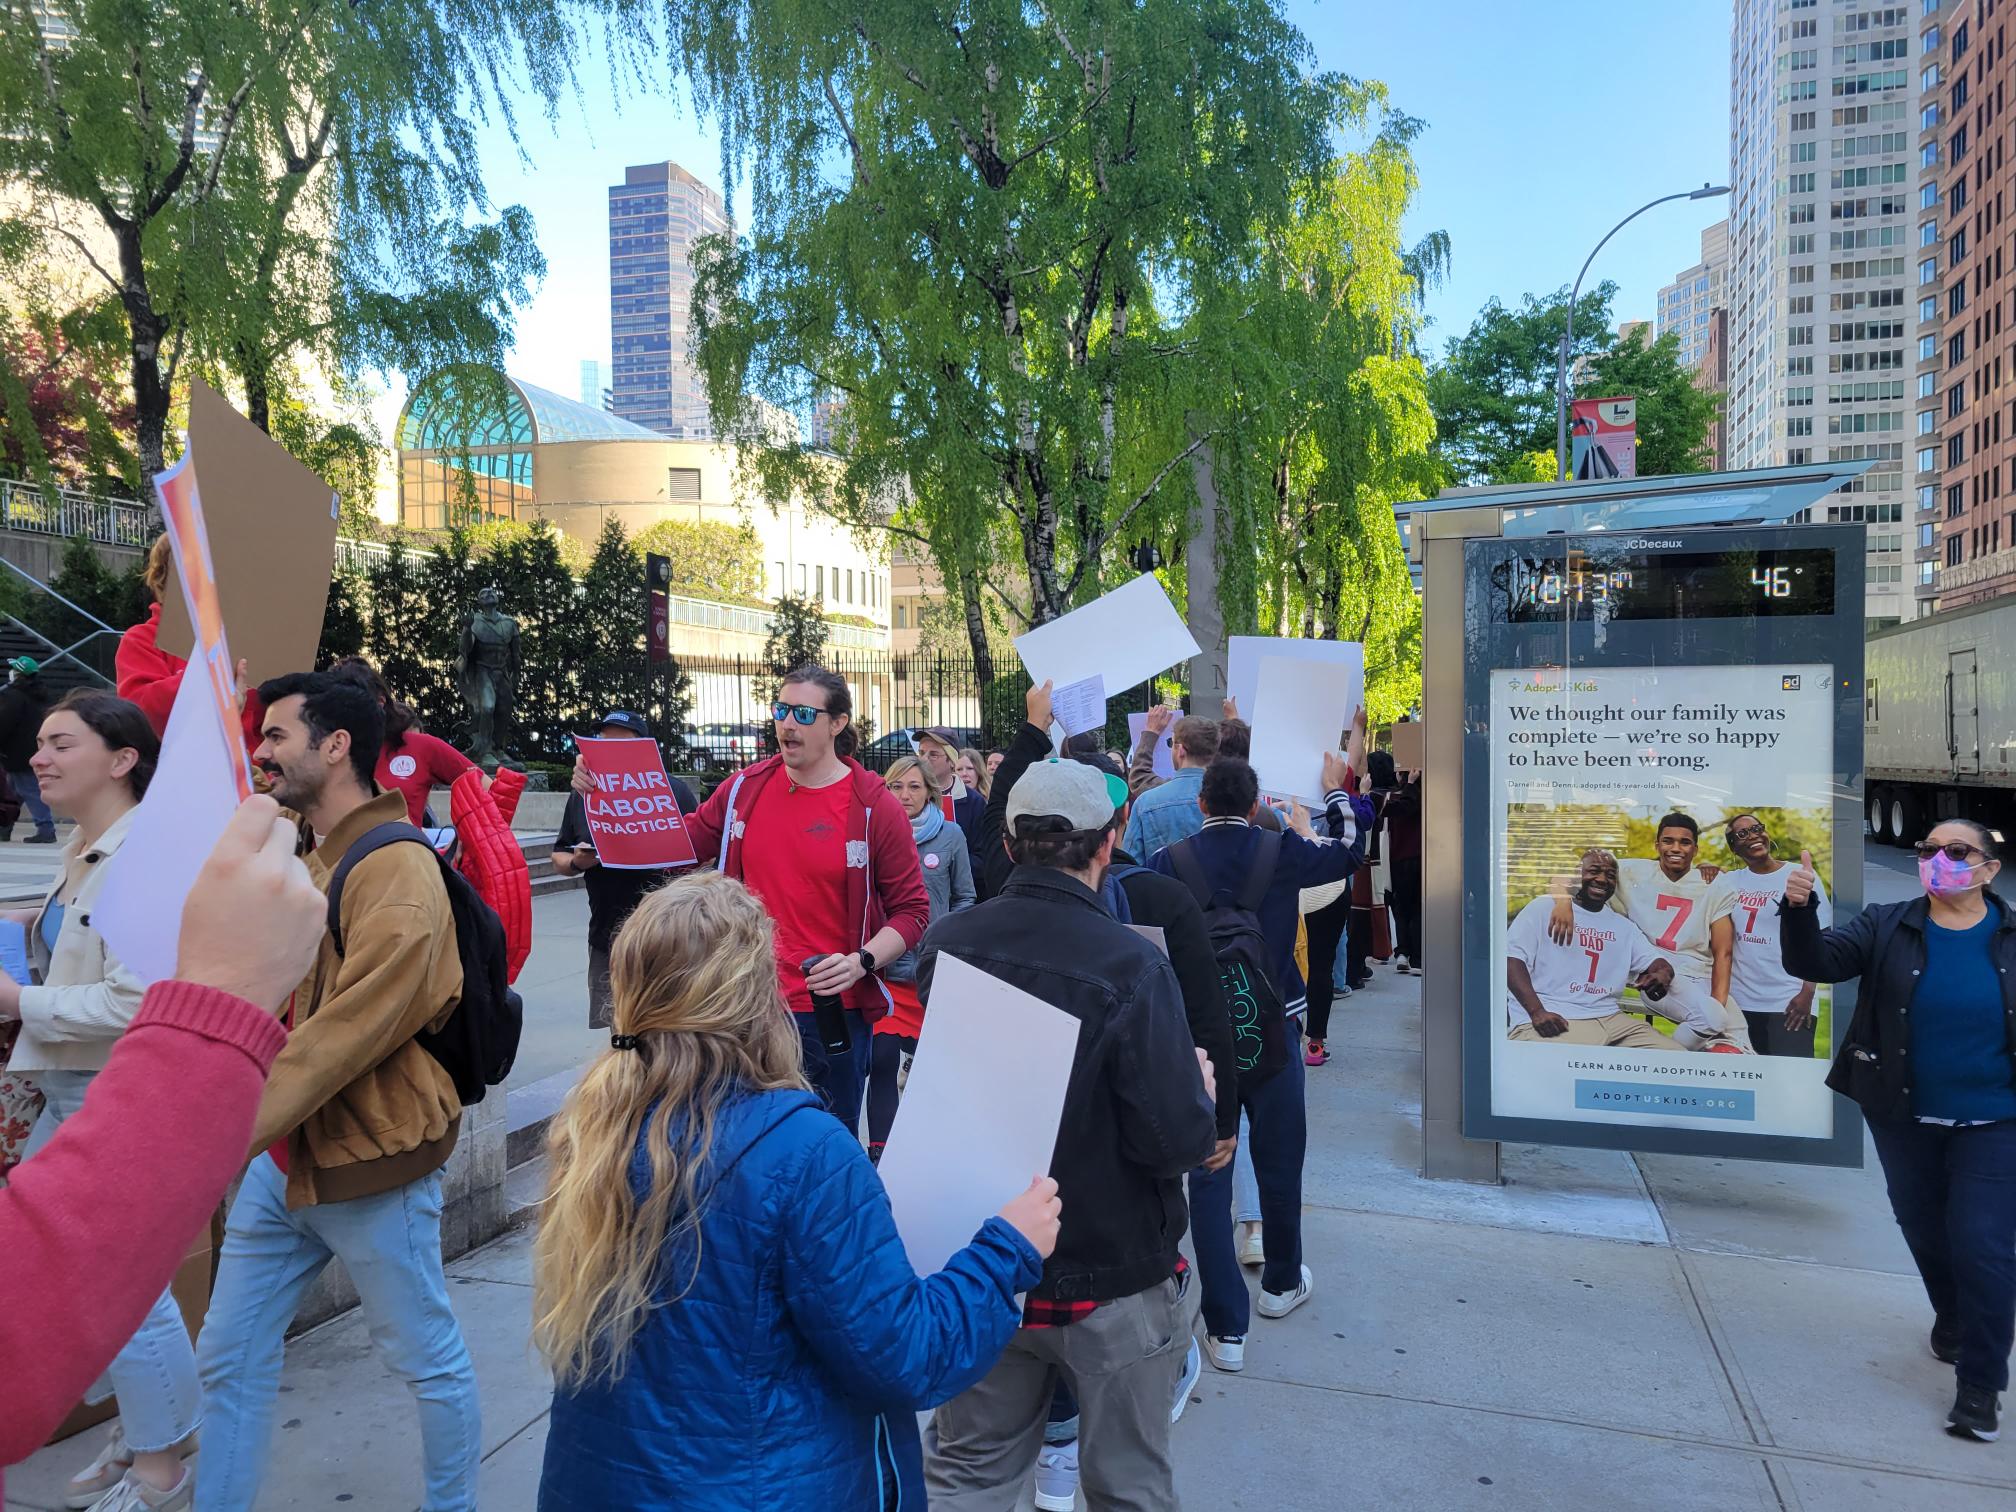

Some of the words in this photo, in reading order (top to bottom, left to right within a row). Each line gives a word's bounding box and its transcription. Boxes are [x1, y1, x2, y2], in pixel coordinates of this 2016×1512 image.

[1623, 539, 1683, 550] JCDecaux
[1530, 574, 1608, 605] 10:13
[1610, 571, 1633, 589] AM
[1508, 706, 1540, 721] We
[1545, 704, 1626, 725] thought
[1631, 709, 1666, 721] our
[1672, 704, 1741, 725] family
[1745, 708, 1786, 721] was
[1508, 728, 1598, 748] complete
[1687, 732, 1710, 744] so
[1716, 727, 1781, 749] happy
[1508, 752, 1528, 767] to
[1533, 750, 1579, 767] have
[1584, 750, 1632, 767] been
[1638, 755, 1710, 772] wrong.
[590, 771, 668, 793] NFAIR
[1536, 780, 1550, 788] and
[1580, 781, 1611, 790] adopted
[1613, 781, 1656, 790] 16-year-old
[1657, 781, 1680, 789] Isaiah
[586, 794, 677, 818] LABOR
[590, 816, 682, 836] PRACTICE
[1737, 894, 1768, 907] MOM
[1655, 893, 1694, 953] 7
[1742, 905, 1759, 934] 7
[1575, 925, 1616, 942] ootball
[1579, 933, 1604, 952] DAD
[1584, 949, 1600, 984] 7
[1569, 981, 1582, 994] Go
[1568, 1060, 1604, 1070] LEARN
[1608, 1063, 1648, 1073] ABOUT
[1653, 1067, 1716, 1077] ADOPTING
[1732, 1071, 1763, 1080] TEEN
[1593, 1091, 1737, 1109] ADOPTUSKIDS.ORG
